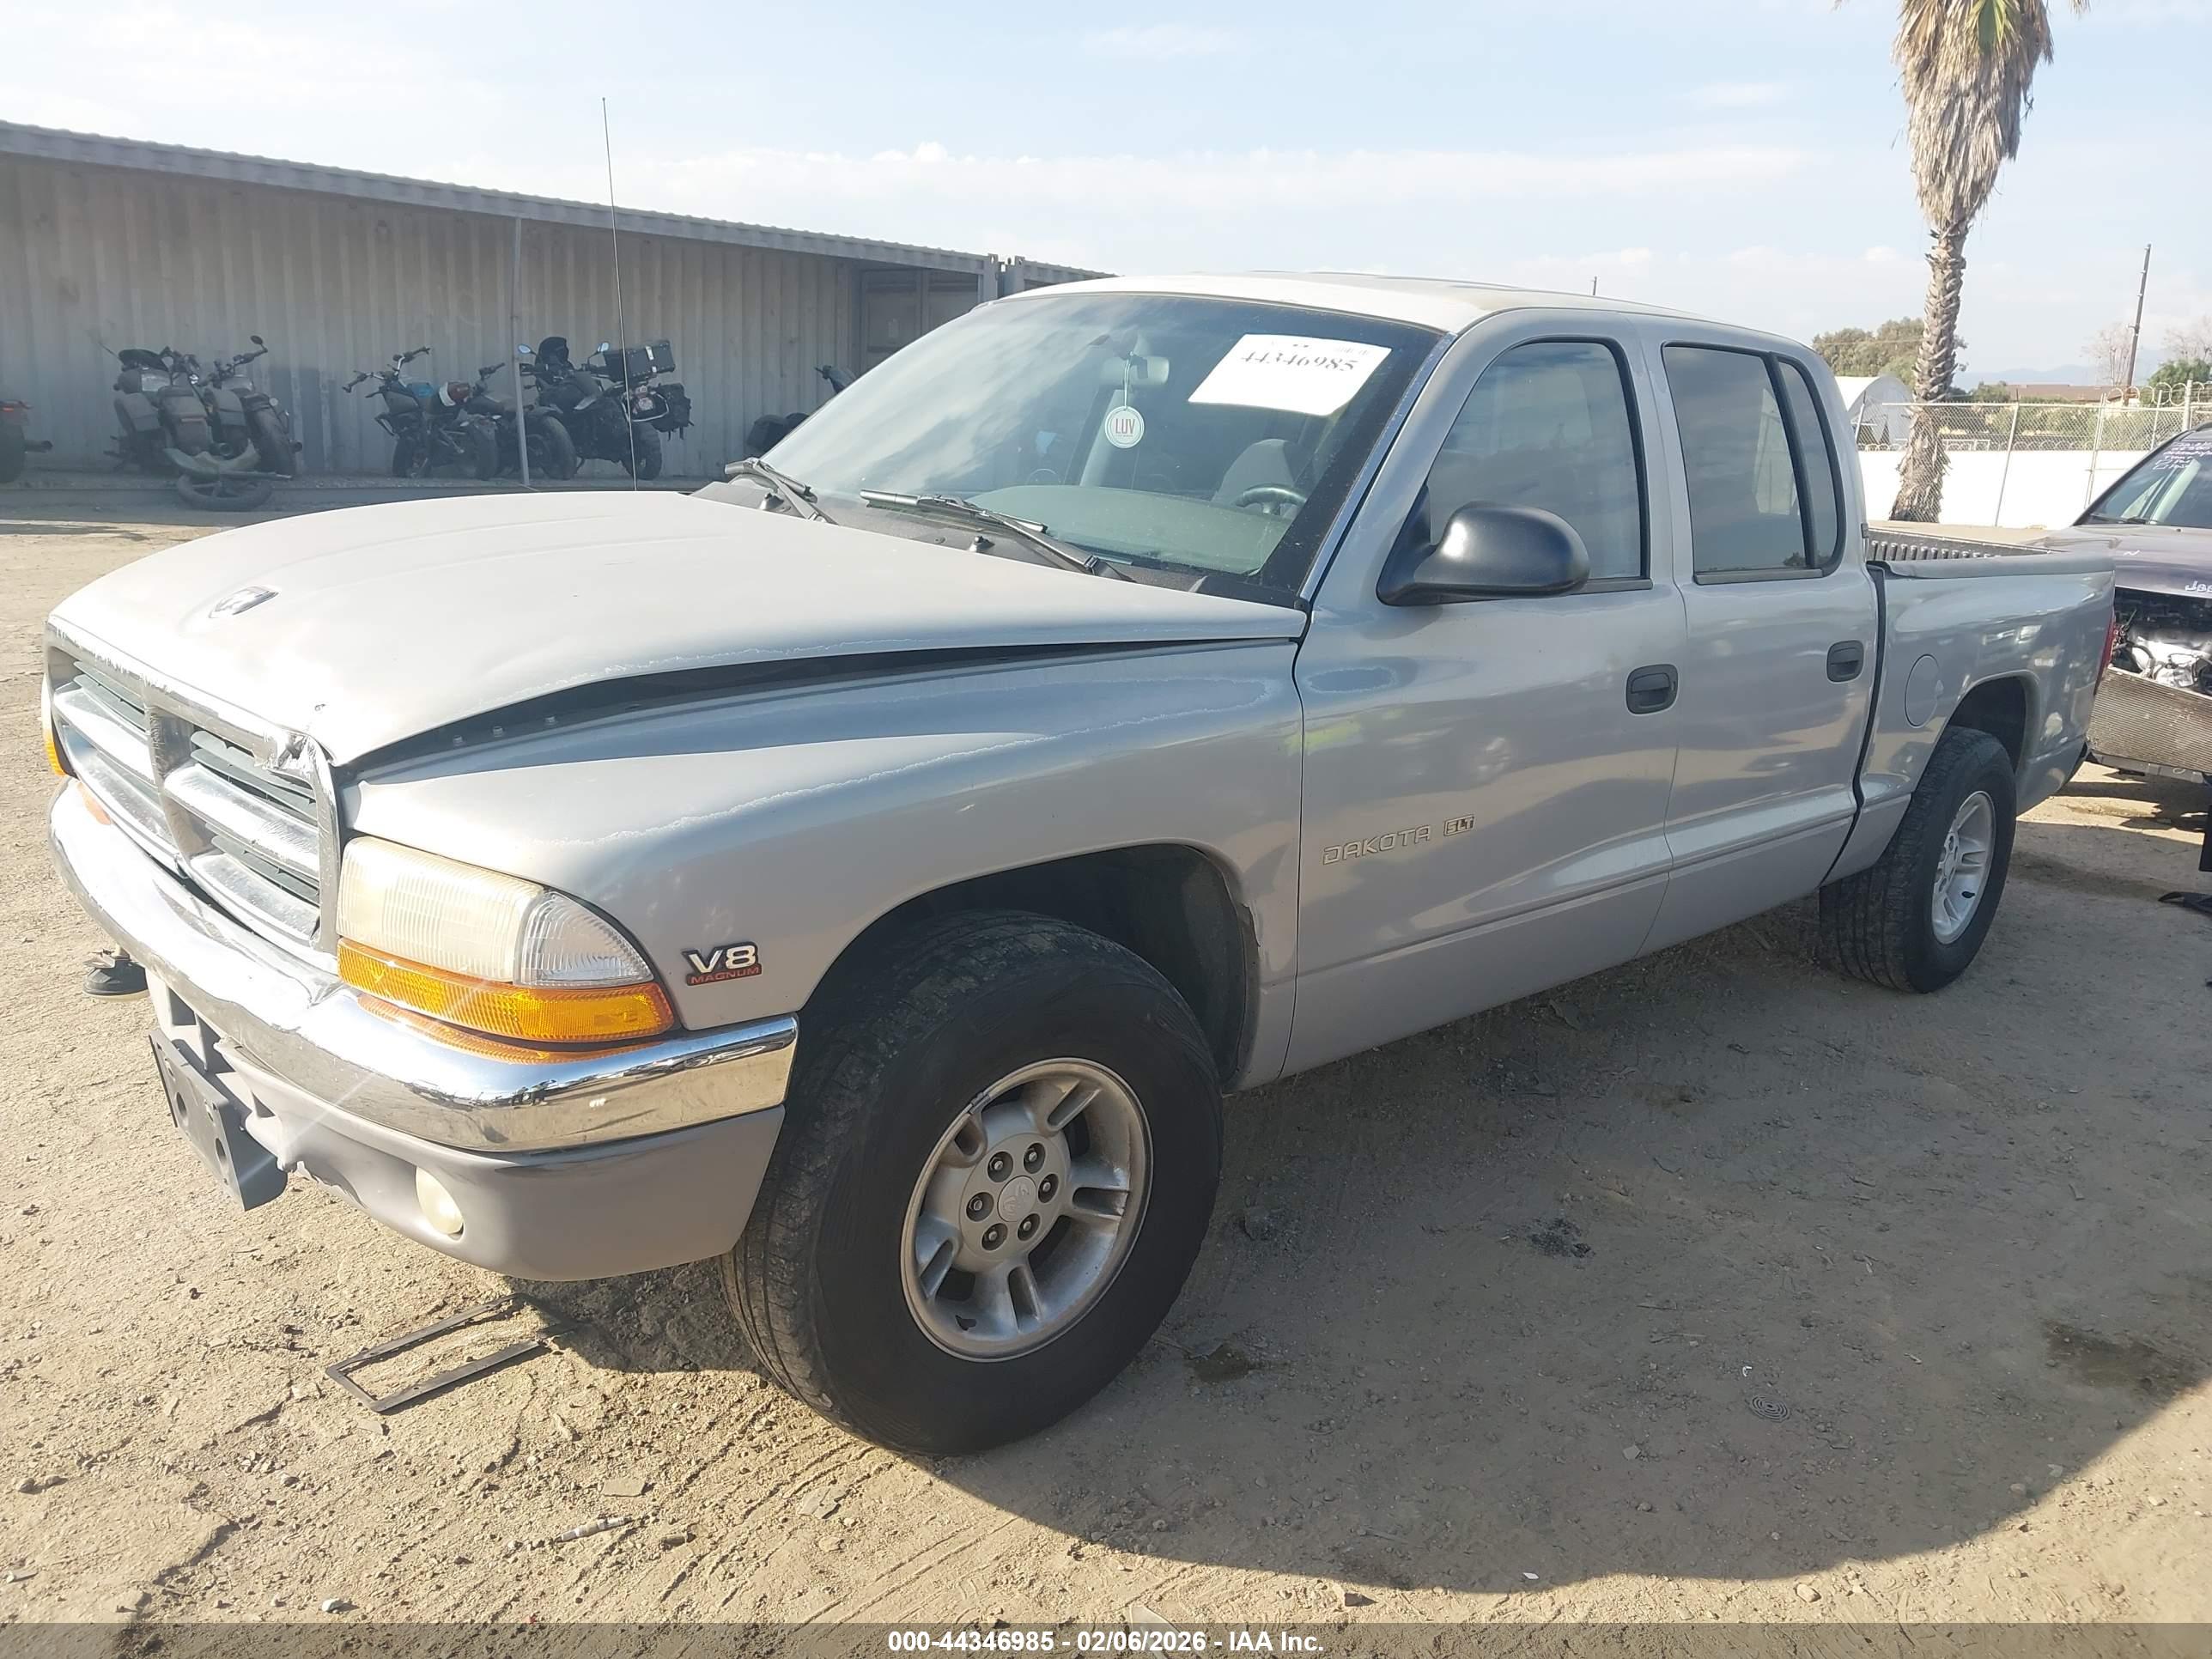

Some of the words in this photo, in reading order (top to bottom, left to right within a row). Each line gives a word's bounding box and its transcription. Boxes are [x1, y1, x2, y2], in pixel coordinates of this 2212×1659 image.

[1241, 350, 1359, 371] 44346985
[1115, 418, 1135, 434] LUV
[1322, 824, 1432, 866] DAKOTA
[1445, 814, 1475, 836] SLT
[686, 943, 757, 975] V8
[690, 967, 760, 984] MAGNUM
